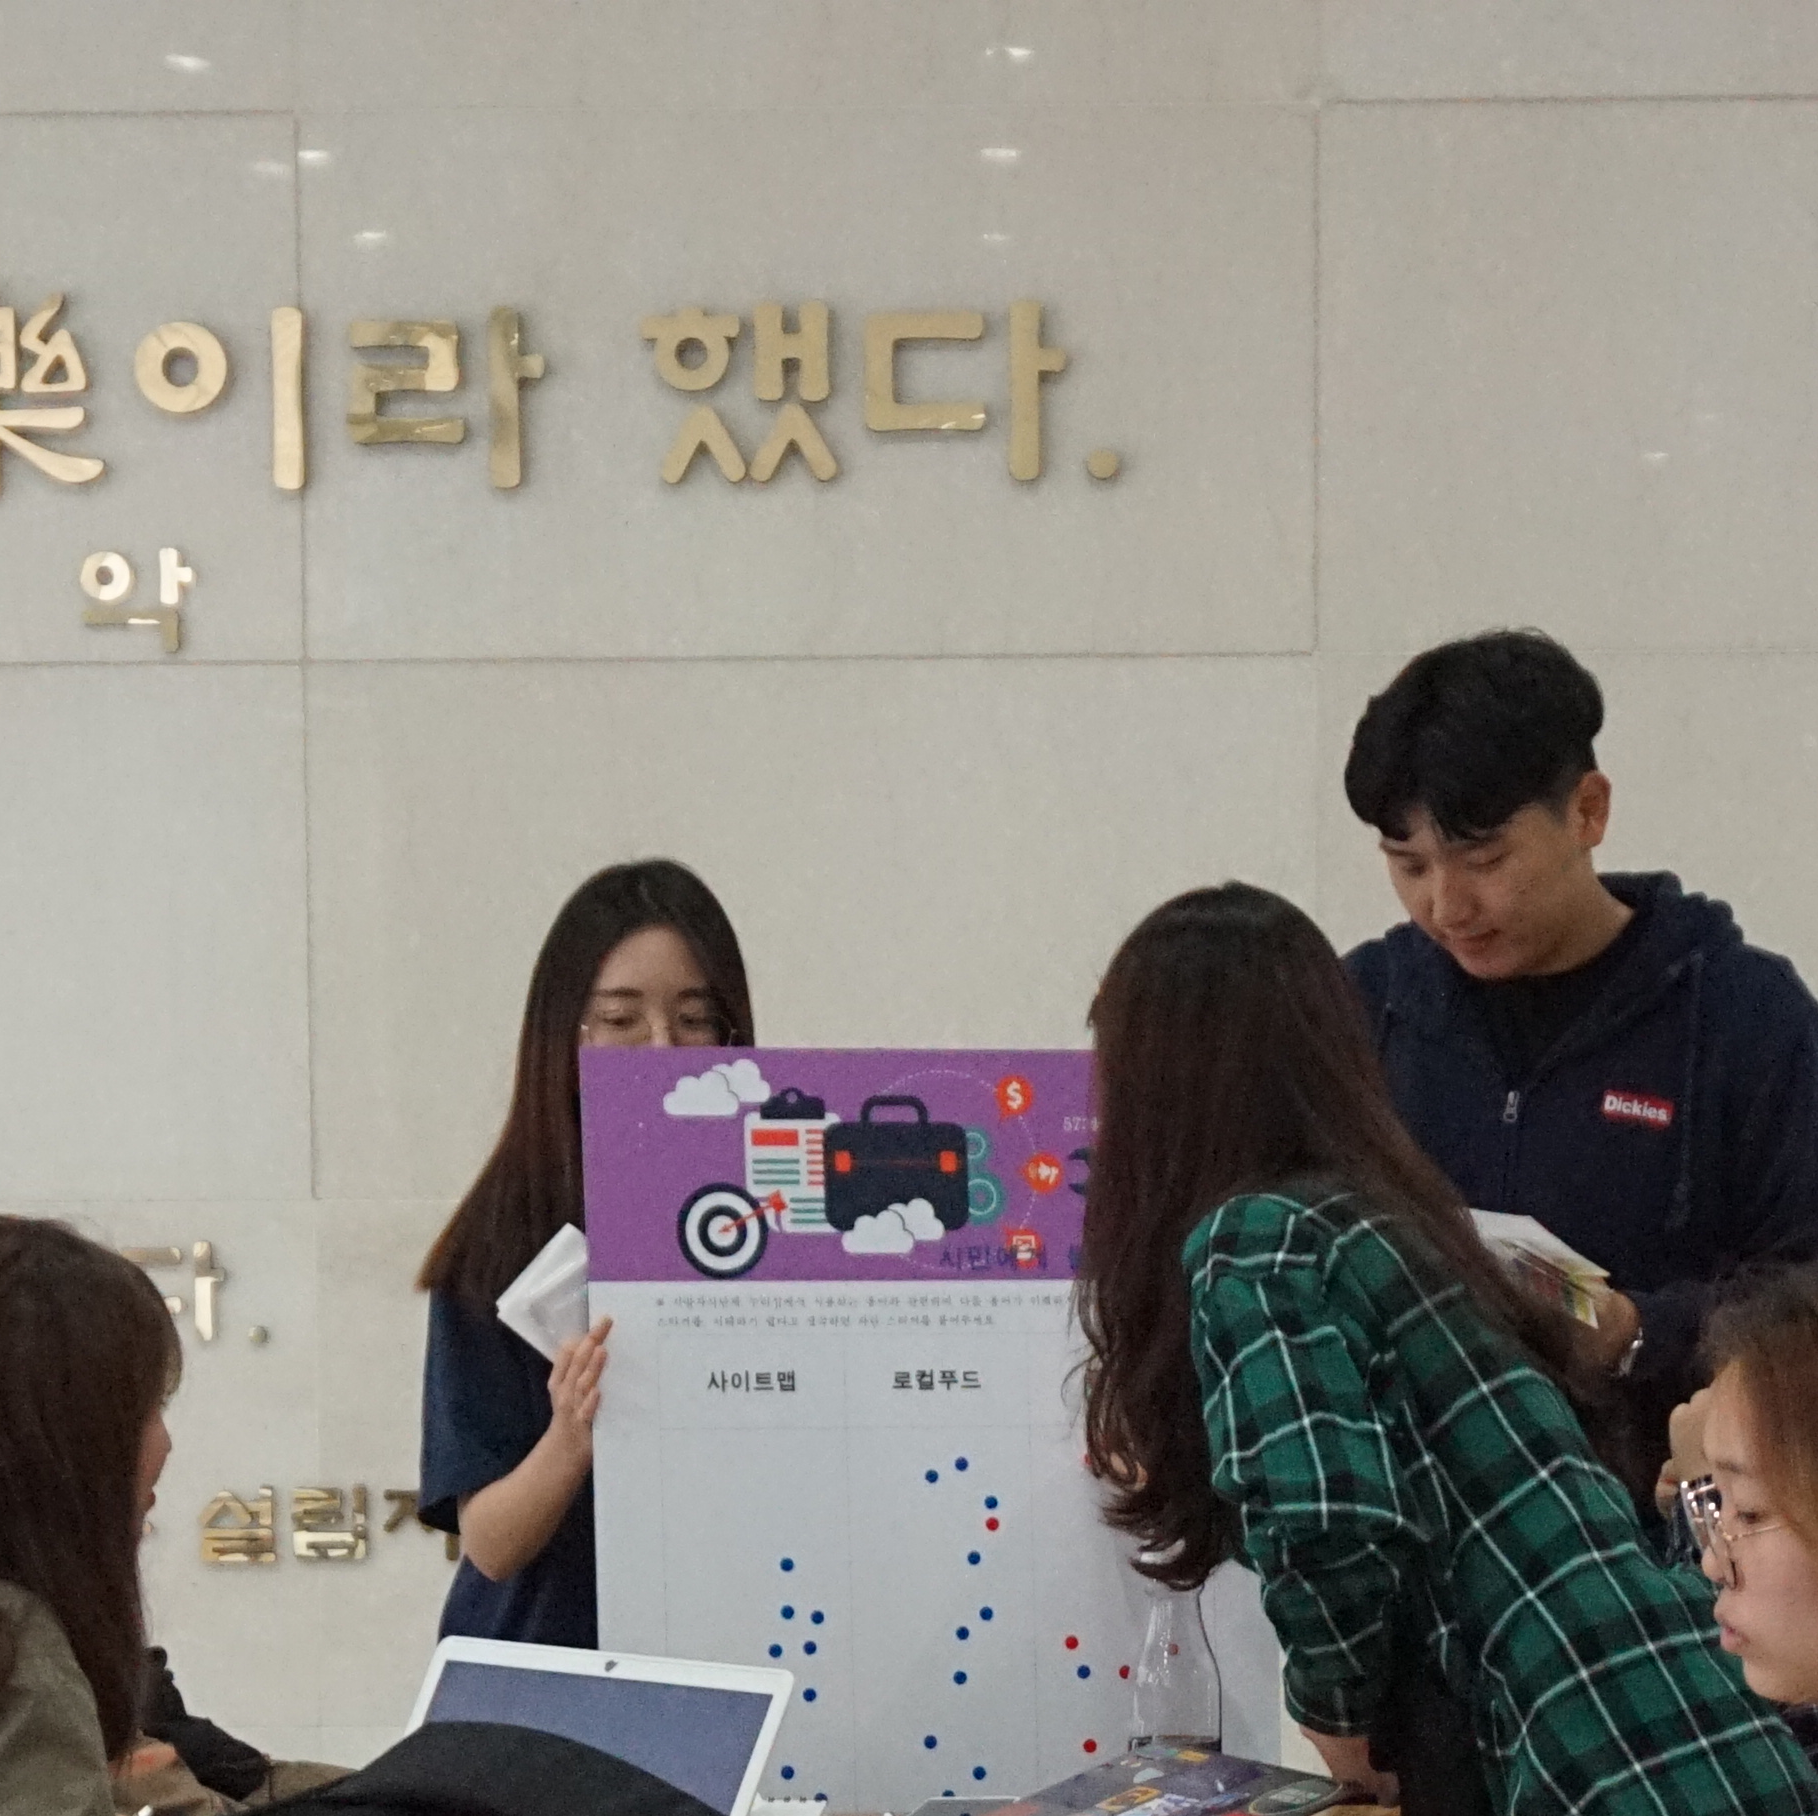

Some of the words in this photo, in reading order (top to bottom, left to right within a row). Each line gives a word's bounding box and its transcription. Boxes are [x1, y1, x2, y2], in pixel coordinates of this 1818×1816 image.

[639, 300, 1119, 484] 했다.
[79, 547, 194, 653] 악
[1604, 1094, 1669, 1122] Dickies
[707, 1369, 797, 1393] 사이트맵
[892, 1368, 982, 1391] 로컬푸드
